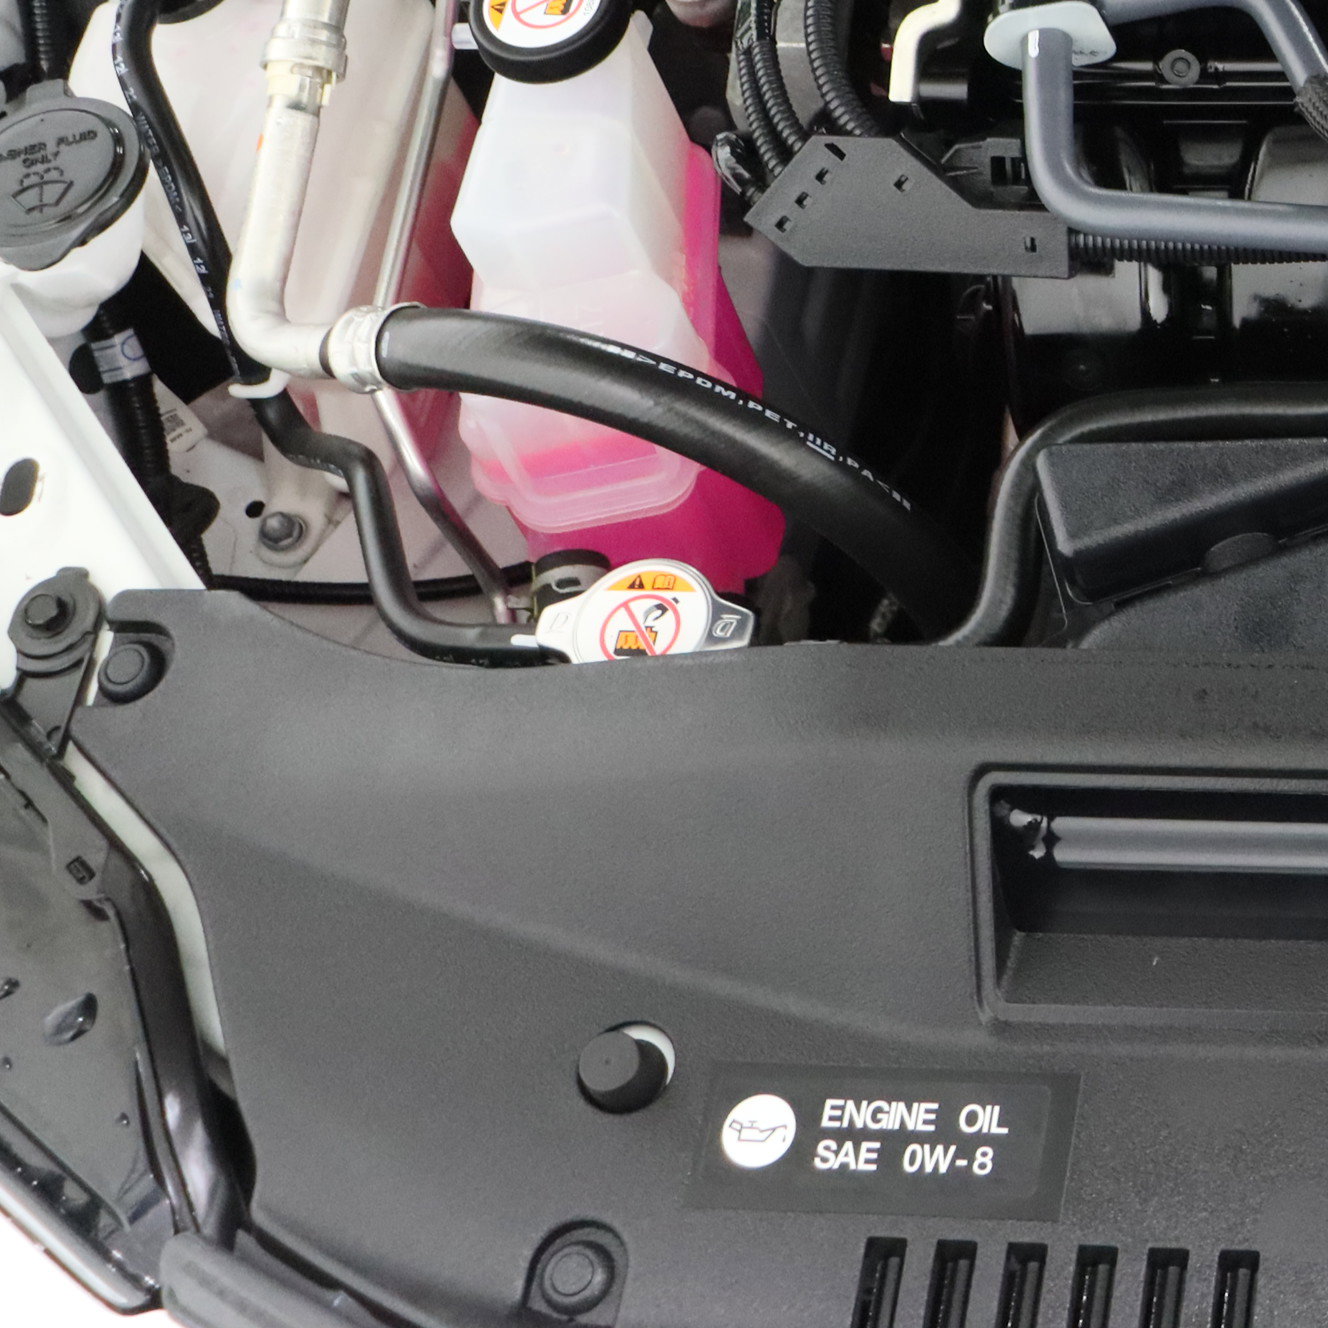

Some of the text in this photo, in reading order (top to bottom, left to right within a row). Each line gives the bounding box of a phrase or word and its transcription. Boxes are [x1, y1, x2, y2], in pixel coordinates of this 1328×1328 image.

[0, 130, 98, 161] ASHER FLUID
[22, 150, 60, 168] ONLY
[820, 1098, 1009, 1134] ENGINE OIL
[813, 1138, 994, 1176] SAE 0W-8
